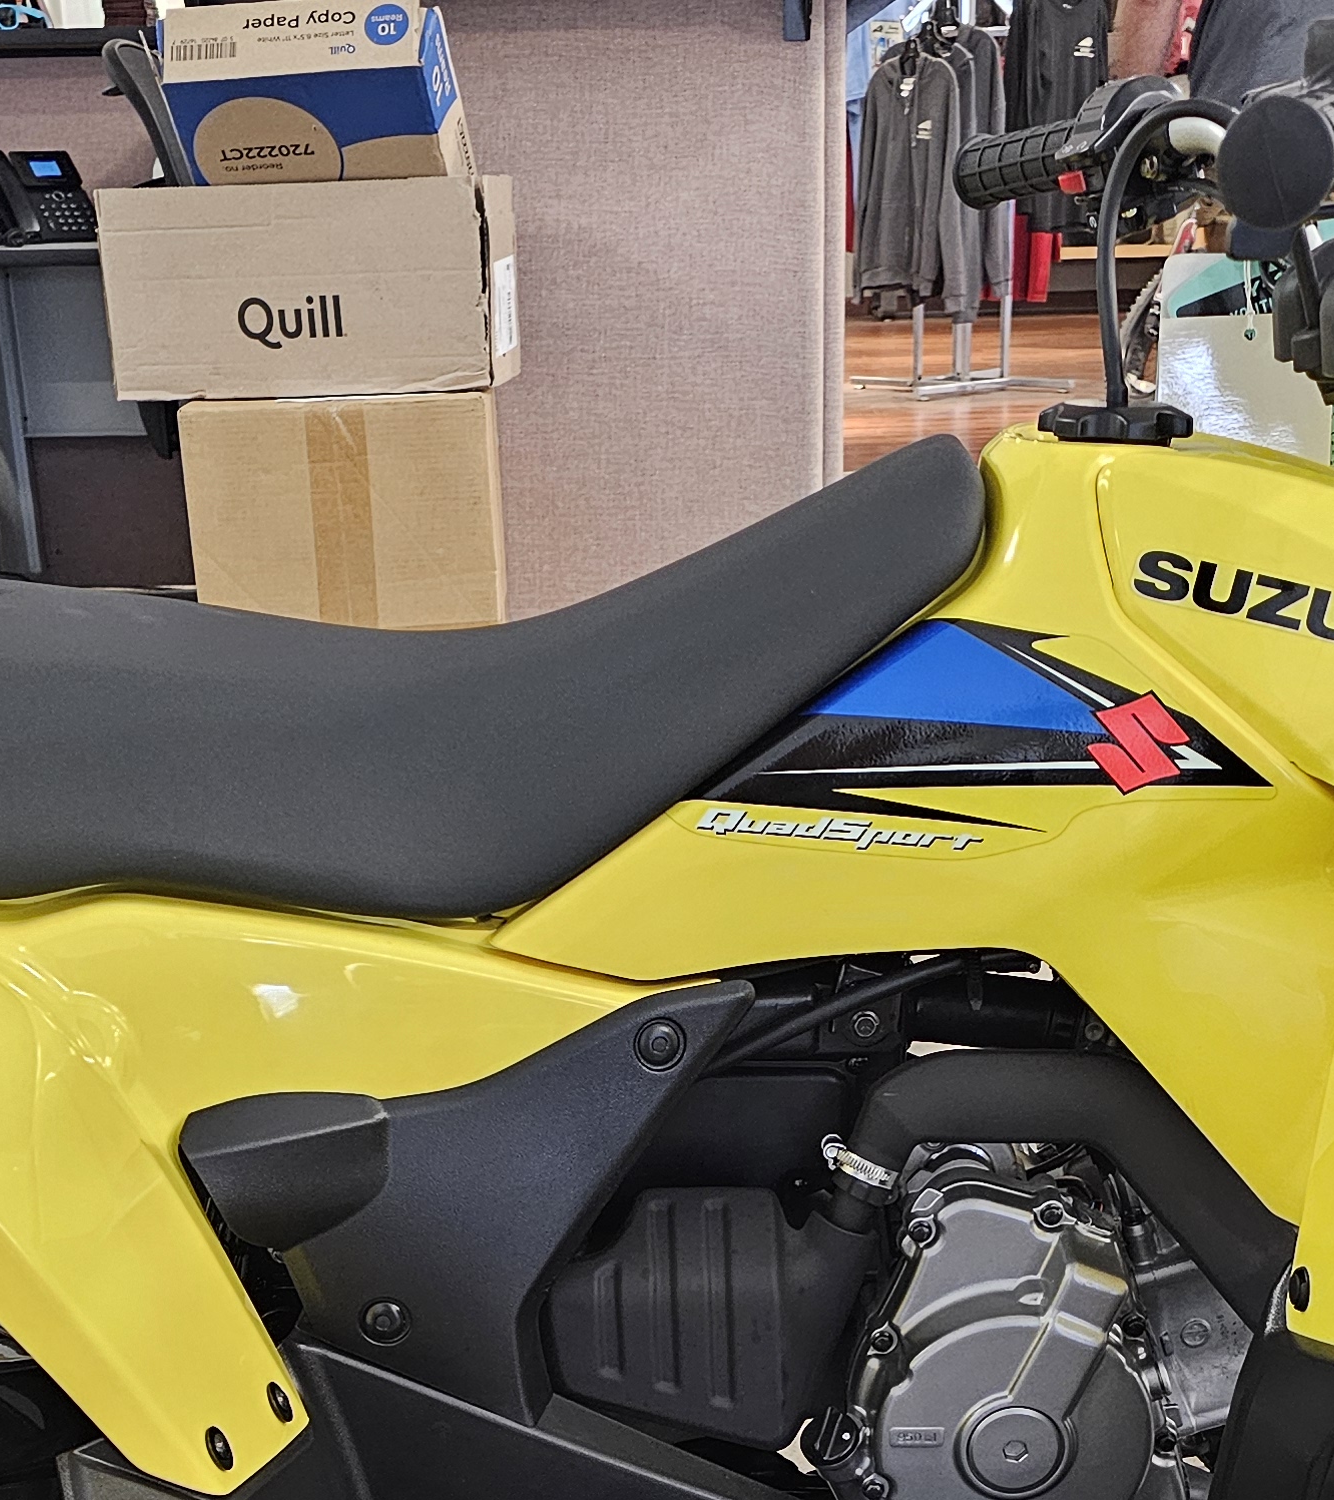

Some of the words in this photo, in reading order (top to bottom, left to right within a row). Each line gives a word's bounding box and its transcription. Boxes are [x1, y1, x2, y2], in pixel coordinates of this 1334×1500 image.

[242, 15, 301, 30] Paper
[306, 10, 356, 24] Copy
[370, 13, 404, 23] Reams
[313, 31, 329, 39] Size
[330, 29, 355, 38] Letter
[378, 24, 397, 36] 10
[256, 34, 280, 43] White
[329, 43, 356, 55] Quill
[219, 143, 315, 163] 720222CT
[240, 162, 284, 173] Reorder
[237, 294, 346, 349] Quill
[695, 807, 984, 851] QuadSport
